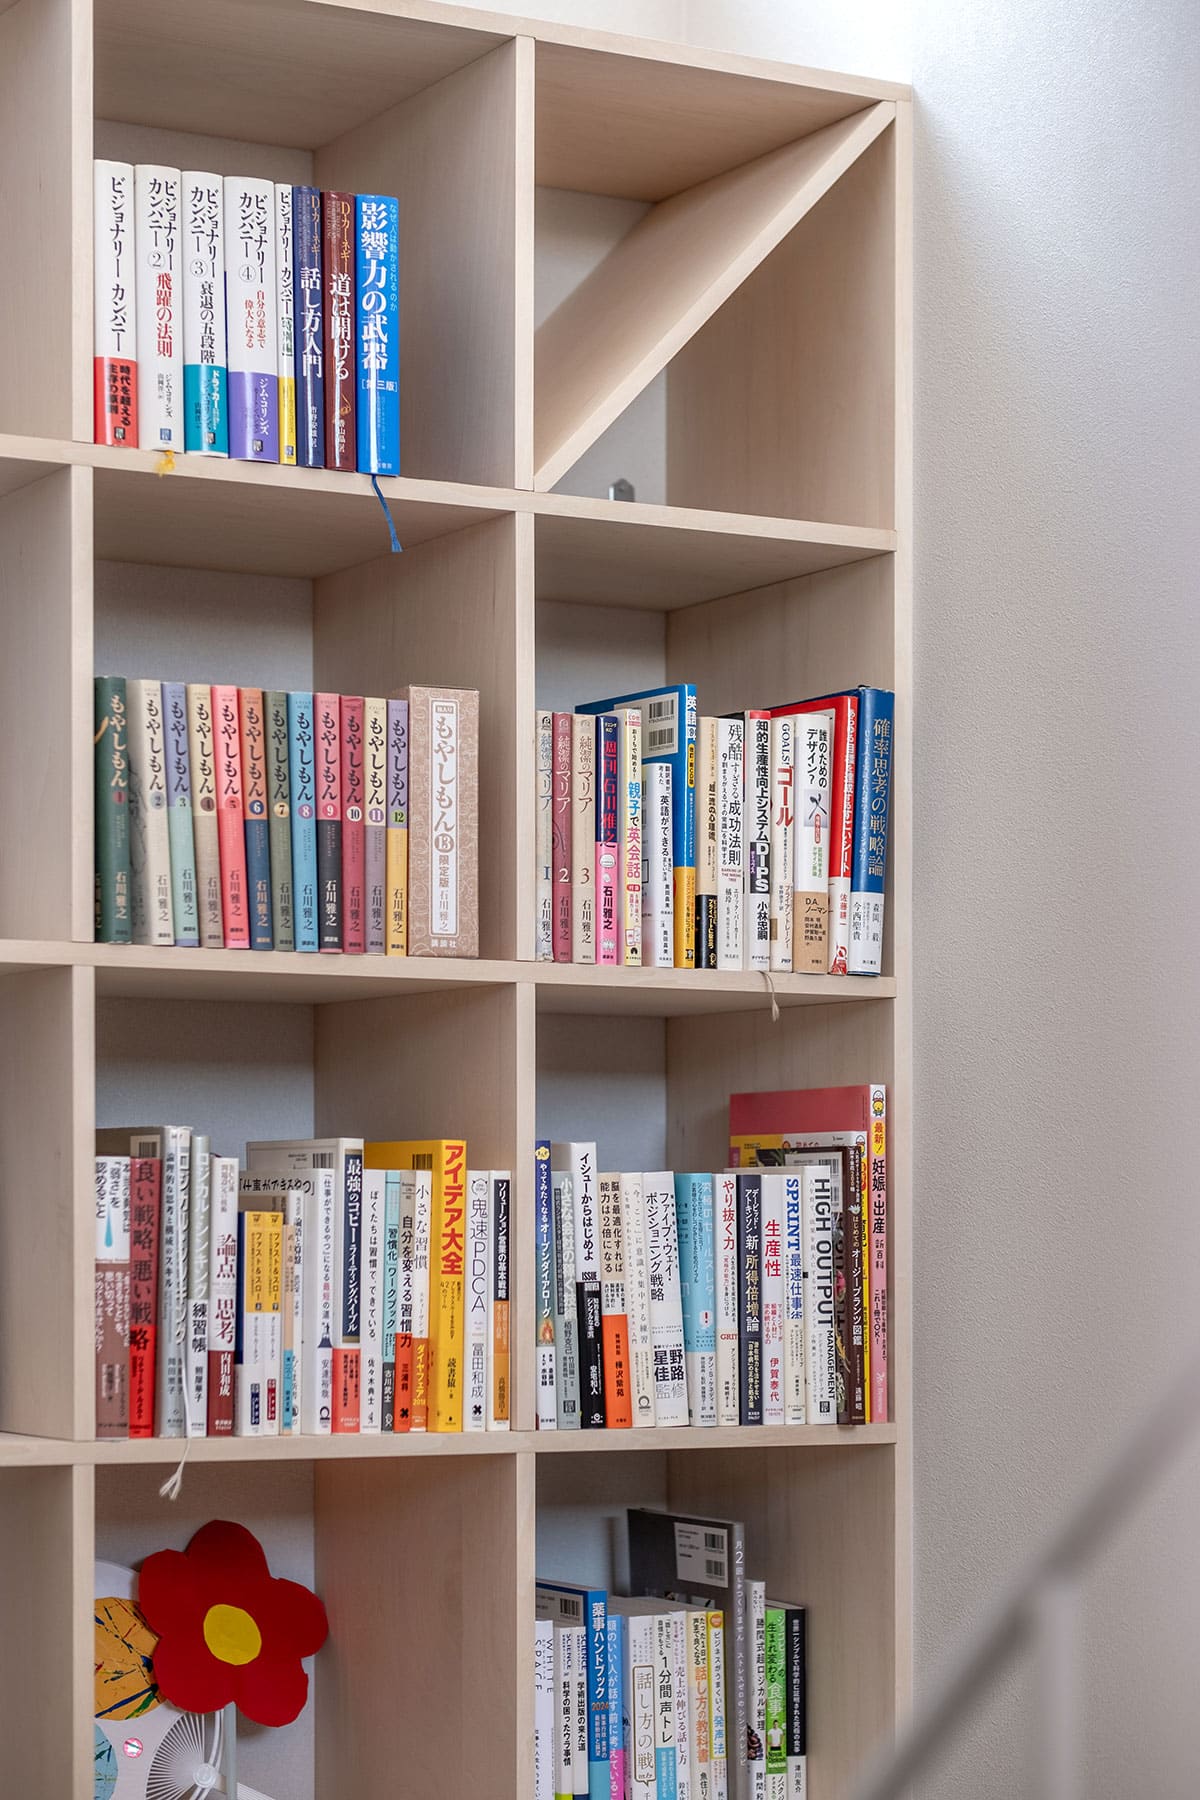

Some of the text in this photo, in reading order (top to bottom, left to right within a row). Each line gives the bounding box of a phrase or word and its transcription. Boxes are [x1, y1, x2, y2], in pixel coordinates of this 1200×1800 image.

[148, 178, 163, 247] カンパニー
[164, 181, 177, 271] ビジョナリー
[190, 186, 205, 252] カンパニー
[205, 188, 219, 278] ビジョナリー
[239, 192, 254, 258] カンパニー
[254, 195, 267, 283] ビジョナリー
[280, 192, 292, 314] ビジョナリー カンパニー
[110, 177, 126, 352] ビジョナリー カンパニー
[361, 202, 388, 370] 影響力の武器
[156, 273, 172, 358] 飛躍の法則
[200, 281, 215, 364] 衰退の五段階
[301, 267, 322, 378] 話し方入門
[329, 273, 351, 380] 道は開ける
[259, 378, 269, 435] ジム・コリンズ
[110, 695, 128, 788] もやしもん
[146, 700, 164, 791] もやしもん
[171, 702, 189, 792] もやしもん
[196, 704, 214, 795] もやしもん
[221, 705, 240, 795] もやしもん
[245, 707, 264, 797] もやしもん
[272, 710, 288, 799] もやしもん
[296, 712, 313, 801] もやしもん
[321, 712, 338, 800] もやしもん
[346, 715, 362, 803] もやしもん
[368, 717, 384, 805] もやしもん
[390, 719, 407, 807] もやしもん
[434, 715, 456, 832] もやしもん
[775, 723, 794, 827] GOALS! ゴール
[818, 729, 828, 788] 誰のための
[627, 782, 641, 878] 親子で英会話
[660, 795, 671, 856] 英語ができる
[728, 724, 742, 866] 残酷すぎる成功法則
[755, 720, 769, 892] 知的生産性向上システム DIPS
[868, 718, 891, 877] 確率思考の戦略論
[156, 874, 169, 921] 石川雅之
[183, 869, 194, 915] 石川雅之
[256, 880, 269, 927] 石川雅之
[303, 884, 314, 931] 石川雅之
[325, 880, 337, 927] 石川雅之
[350, 886, 360, 932] 石川雅之
[372, 885, 382, 931] 石川雅之
[392, 888, 404, 933] 石川雅之
[438, 890, 450, 932] 石川雅之
[559, 868, 569, 882] 2
[581, 867, 590, 884] 3
[603, 886, 613, 930] 石川雅之
[804, 907, 828, 915] ノーマン
[757, 901, 769, 940] 小林忠嗣
[164, 1153, 175, 1288] 論理的な思考と構成のスキル
[239, 1178, 315, 1196] 「仕事ができるやつ」
[414, 1185, 429, 1270] 小さな習慣
[441, 1145, 463, 1275] アイデア大全
[580, 1153, 595, 1261] イシューからはじめよ
[600, 1182, 613, 1272] 能力は2倍になる
[611, 1181, 623, 1272] 脳を最適化すれば
[722, 1180, 735, 1250] やり抜く力
[745, 1189, 753, 1232] アトキンソン
[872, 1159, 886, 1234] 妊娠・出産
[130, 1162, 154, 1351] 良い戦略、悪い戦略
[255, 1232, 263, 1301] ファスト&スロー
[272, 1233, 280, 1301] ファスト&スロー
[322, 1174, 332, 1319] 「仕事ができるやつ」になる最短の道
[347, 1159, 362, 1333] 最強のコピーライティングバイブル
[367, 1190, 379, 1342] ぼくたちは習慣で、できている。
[386, 1223, 399, 1329] 「習慣化」ワークブック
[470, 1198, 487, 1312] 鬼速PDCA
[498, 1182, 507, 1298] ソリューション営業の基本戦略
[540, 1163, 552, 1318] やってみたくなるオープンダイアローグ
[582, 1272, 598, 1280] ISSUE
[646, 1192, 664, 1301] ポジショニング戦略
[660, 1193, 673, 1281] ファイブ・ウェイ・
[765, 1219, 782, 1277] 生産性
[786, 1178, 802, 1319] SPRINT 最速仕事法
[215, 1233, 236, 1343] 論点思考
[400, 1216, 413, 1347] 自分を変える習慣力
[745, 1235, 760, 1333] 新・所得倍増論
[815, 1179, 835, 1400] HIGH OUTPUT MANAGEMENT
[852, 1249, 862, 1345] オージープランツ図鑑
[192, 1302, 207, 1353] 練習帳
[416, 1344, 425, 1396] ダイヤフェア
[654, 1349, 683, 1365] 星野
[321, 1360, 330, 1398] 安達裕哉
[367, 1359, 375, 1405] 佐々木典士
[655, 1366, 685, 1382] 佳路
[769, 1357, 779, 1401] 伊賀泰代
[592, 1602, 605, 1698] 薬事ハンドブック
[756, 1619, 765, 1730] 勝間式超ロジカル料理
[767, 1624, 776, 1683] 生まれ変わる
[792, 1619, 801, 1752] 世界一シンプルで科学的に証明された究極の食事
[562, 1681, 571, 1766] 科学の困ったウラ事情
[577, 1682, 586, 1752] 学術出版の来た道
[659, 1656, 673, 1743] 1分間声トレ
[675, 1667, 687, 1765] 売上が伸びる話し方
[696, 1667, 708, 1762] 話し方の教科書
[714, 1715, 724, 1754] 発声法
[768, 1683, 783, 1718] 食事
